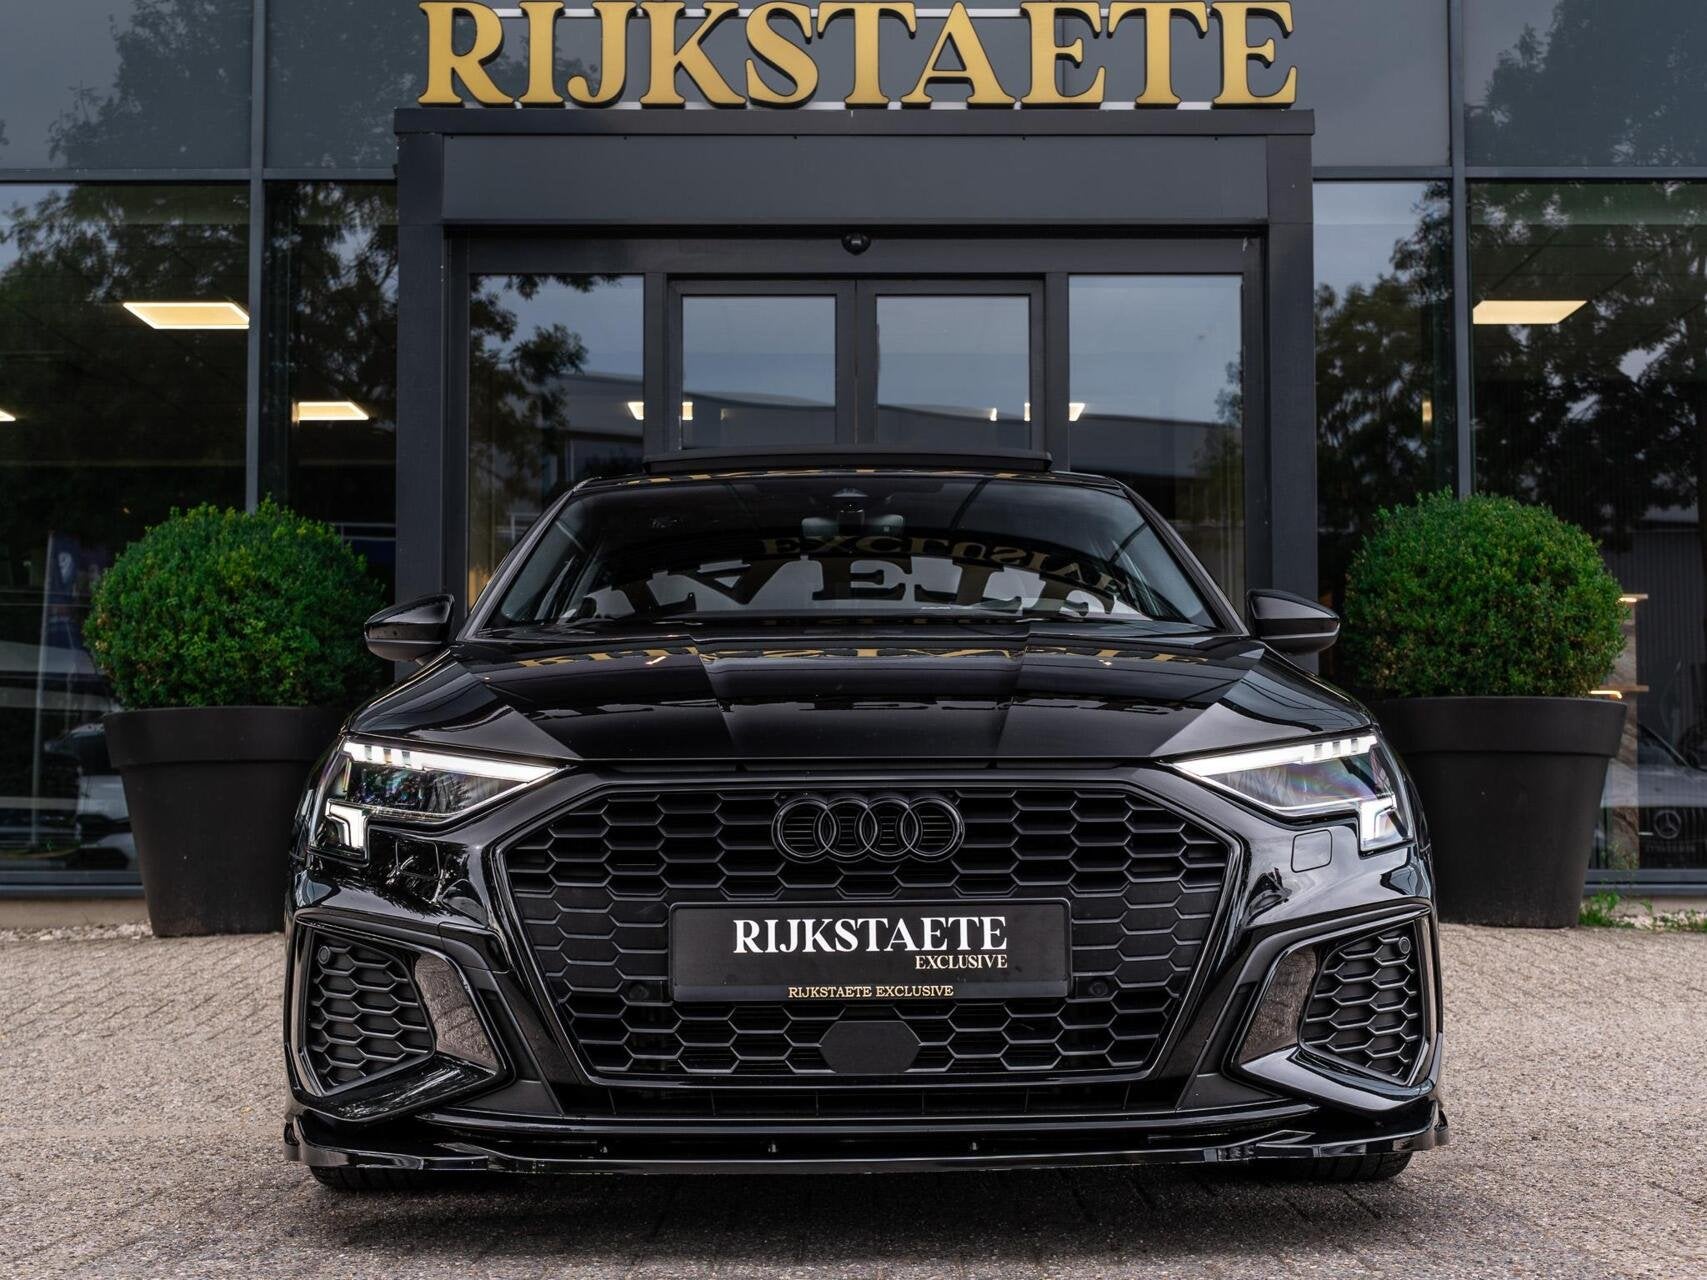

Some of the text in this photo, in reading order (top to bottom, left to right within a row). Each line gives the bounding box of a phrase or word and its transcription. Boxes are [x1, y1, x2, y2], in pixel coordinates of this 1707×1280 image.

[419, 1, 1298, 108] RIJKSTAETE
[733, 916, 1008, 953] RIJKSTAETE
[914, 954, 1008, 970] EXCLUSIVE
[787, 985, 955, 998] RIJKSTAETE EXCLUSIVE
